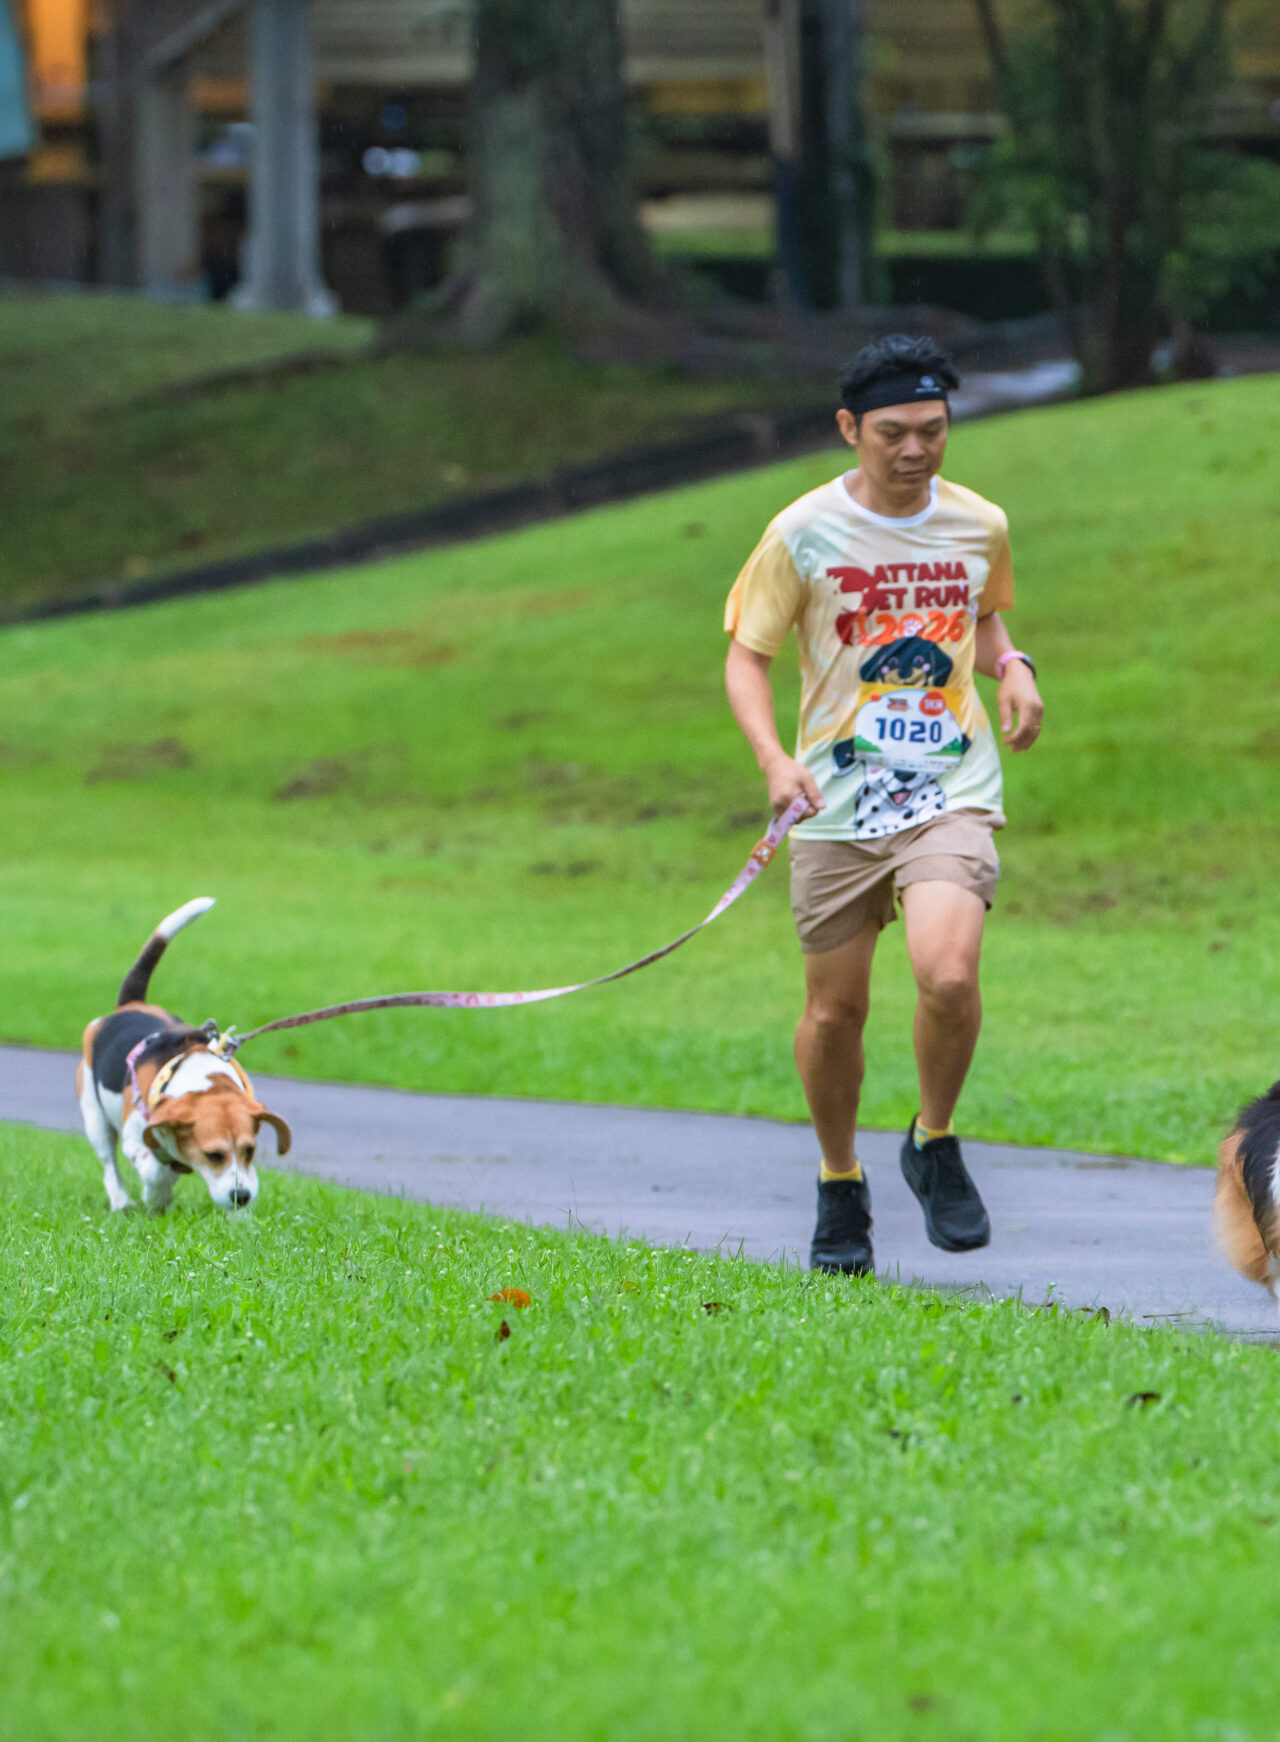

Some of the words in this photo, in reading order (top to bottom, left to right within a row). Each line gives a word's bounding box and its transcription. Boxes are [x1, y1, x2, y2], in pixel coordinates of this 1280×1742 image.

[915, 584, 969, 608] RUN
[875, 609, 966, 646] 2026
[875, 717, 942, 743] 1020
